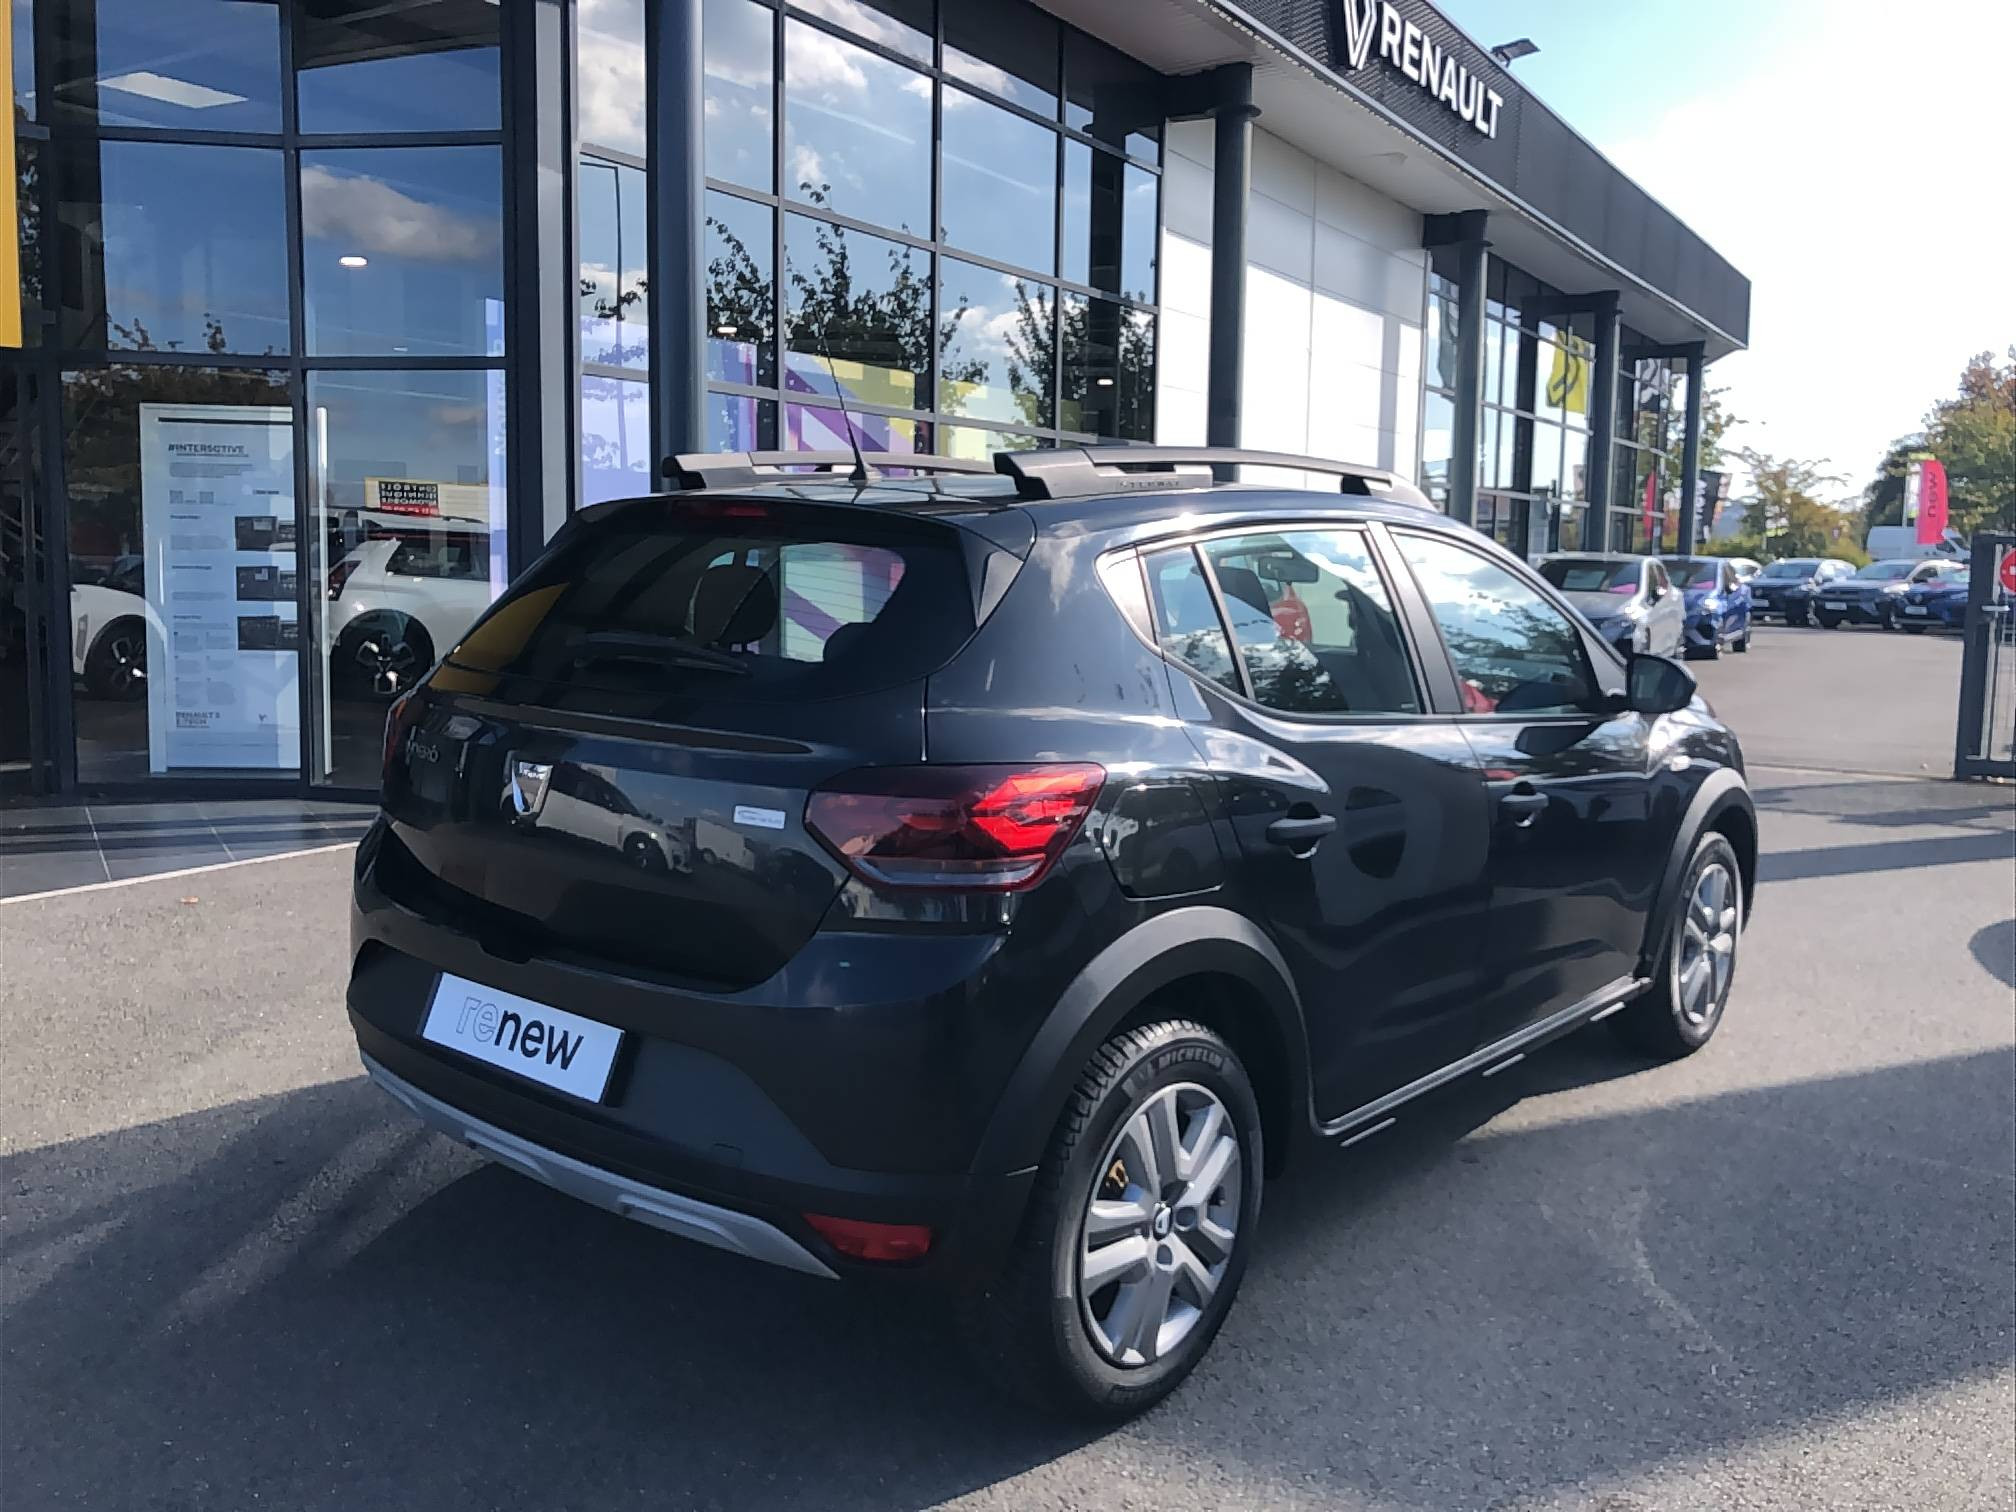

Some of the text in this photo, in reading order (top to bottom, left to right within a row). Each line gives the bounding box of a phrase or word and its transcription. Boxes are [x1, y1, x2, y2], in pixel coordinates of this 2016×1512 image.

[1380, 1, 1503, 139] RENAULT
[456, 996, 584, 1070] renew
[1158, 1048, 1224, 1069] MICHELIN
